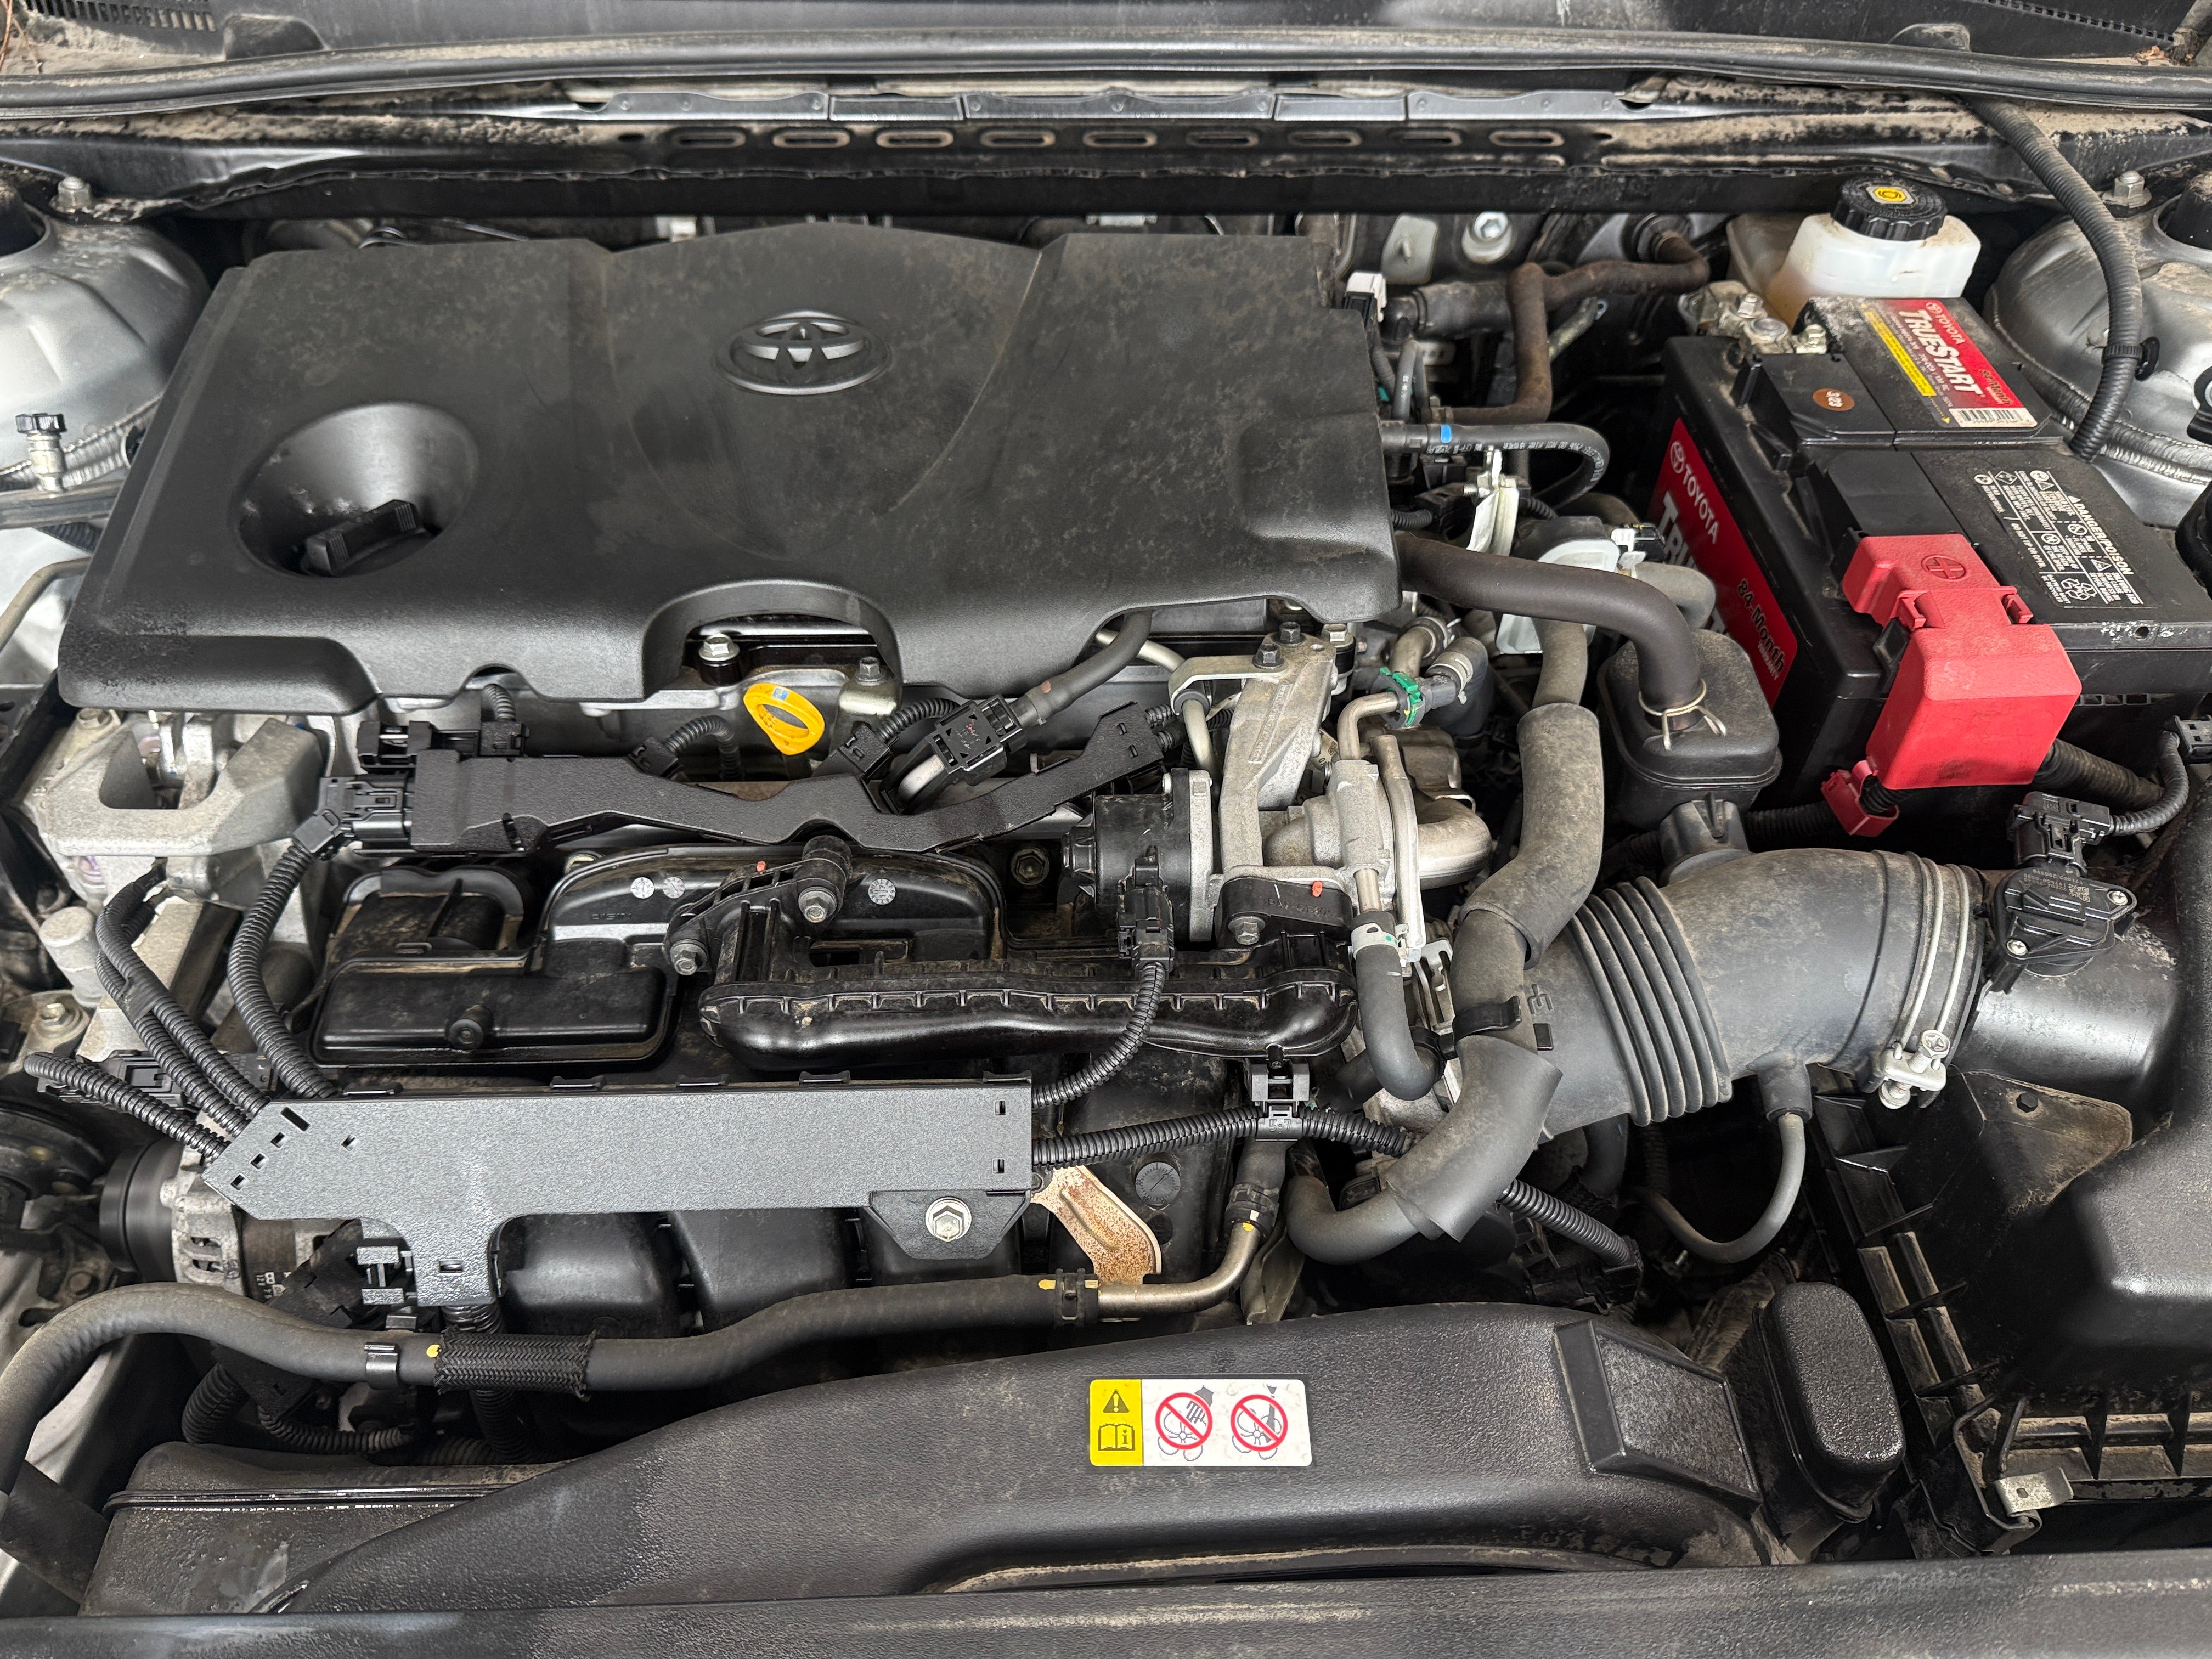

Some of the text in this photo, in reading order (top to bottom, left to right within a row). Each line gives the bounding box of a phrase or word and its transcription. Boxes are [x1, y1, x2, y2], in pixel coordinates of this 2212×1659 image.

[1899, 309, 1984, 395] TRUESTART
[1935, 314, 1966, 345] TOYOTA
[1681, 464, 1720, 545] TOYOTA
[2073, 502, 2134, 575] DANGER/POISON
[1737, 578, 1786, 674] 84-Month
